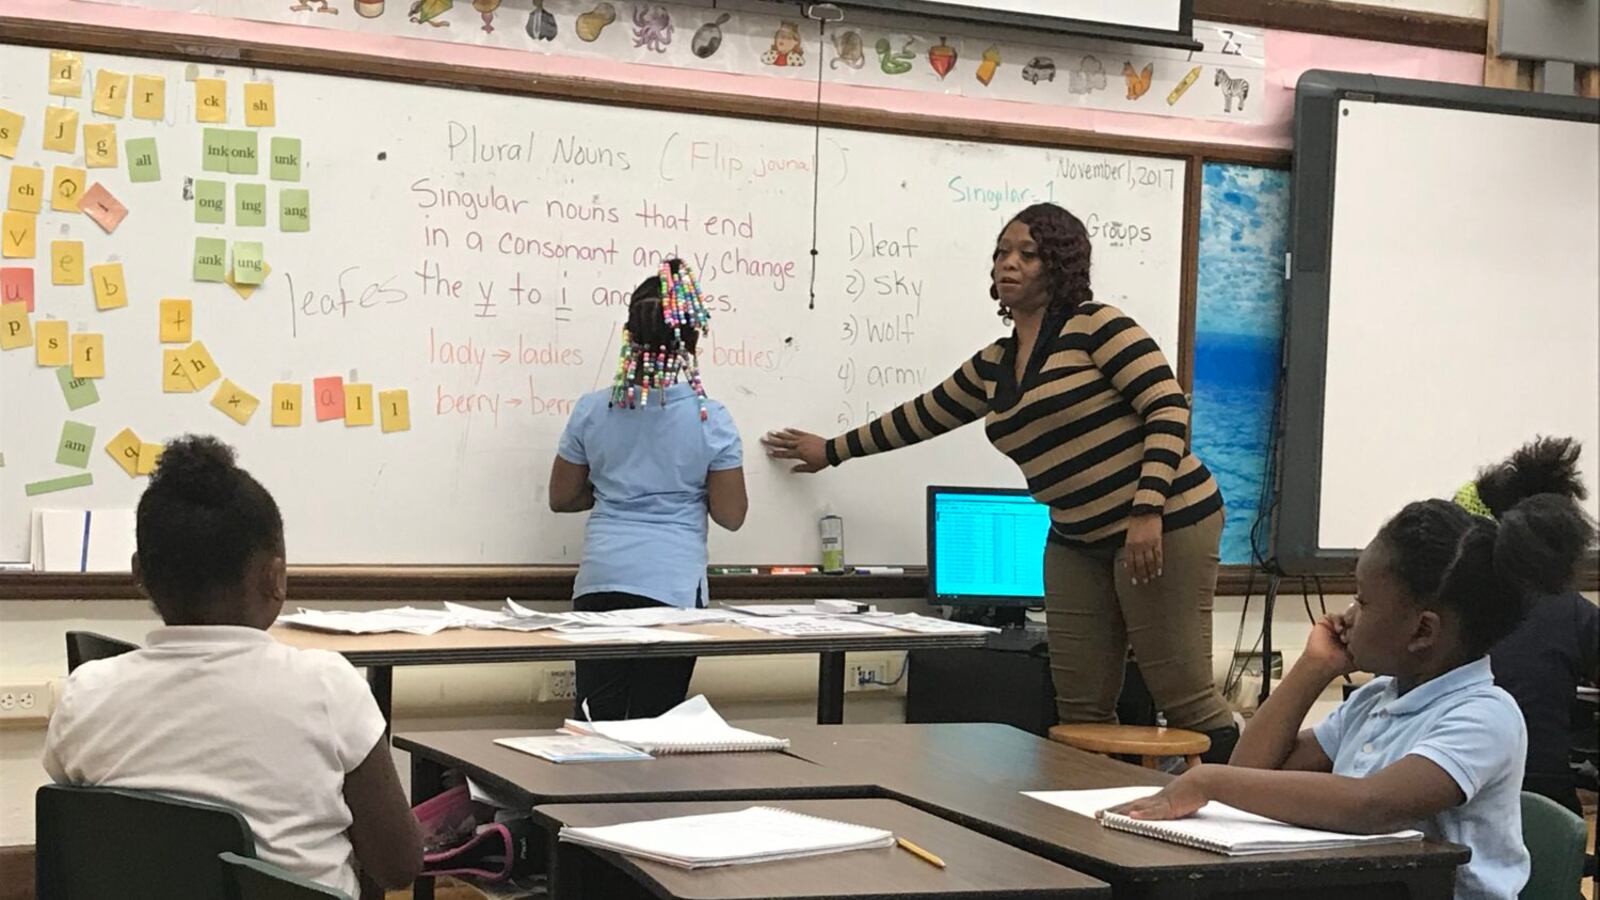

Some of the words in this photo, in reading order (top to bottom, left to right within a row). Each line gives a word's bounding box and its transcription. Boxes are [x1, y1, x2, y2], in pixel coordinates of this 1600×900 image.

[1221, 30, 1242, 56] Zz
[60, 65, 72, 80] d
[108, 84, 117, 99] f
[145, 91, 154, 103] r
[203, 95, 220, 107] ck
[252, 99, 269, 112] sh
[96, 139, 108, 156] g
[208, 144, 229, 157] ink
[231, 146, 255, 159] onk
[448, 120, 535, 164] Plural
[552, 135, 632, 171] Nouns
[135, 154, 152, 167] all
[275, 154, 298, 167] unk
[1057, 157, 1126, 181] November
[18, 183, 35, 197] ch
[198, 198, 223, 212] ong
[241, 199, 262, 214] ing
[284, 206, 308, 219] ang
[411, 177, 529, 221] Singular
[546, 198, 620, 224] nouns
[635, 199, 691, 232] that
[704, 212, 754, 240] end
[424, 222, 450, 249] in
[466, 231, 483, 251] a
[1086, 212, 1152, 246] Groups
[60, 255, 74, 272] e
[198, 253, 223, 267] ank
[237, 257, 263, 271] ung
[102, 276, 119, 297] b
[414, 259, 463, 298] the
[509, 271, 542, 306] to
[5, 283, 24, 301] u
[845, 268, 866, 303] 2)
[873, 269, 924, 317] sky
[8, 320, 21, 337] p
[841, 313, 859, 346] 3)
[48, 337, 59, 350] s
[85, 346, 93, 362] f
[430, 327, 486, 385] lady
[519, 333, 585, 367] ladies
[190, 357, 207, 373] h
[837, 356, 855, 394] 4)
[281, 399, 294, 412] th
[321, 388, 335, 407] a
[436, 384, 500, 429] berry
[529, 375, 577, 416] berr
[64, 438, 87, 454] am
